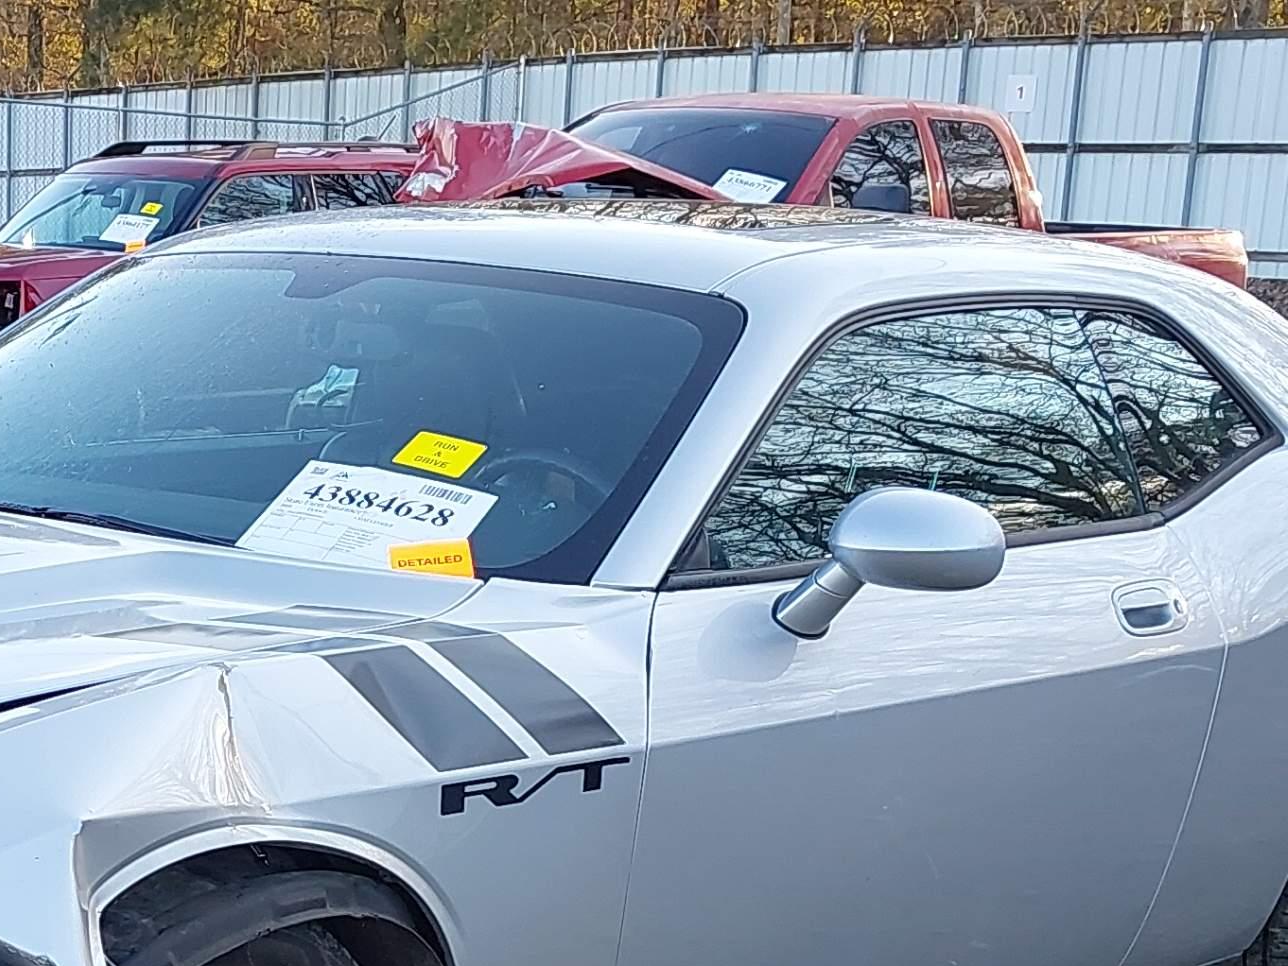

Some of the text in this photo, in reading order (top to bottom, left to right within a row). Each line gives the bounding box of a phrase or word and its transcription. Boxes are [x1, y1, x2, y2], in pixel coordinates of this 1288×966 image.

[1017, 86, 1024, 99] 1
[433, 441, 460, 452] RUN
[414, 455, 451, 469] DRIVE
[304, 483, 455, 527] 43884628
[397, 554, 464, 569] DETAILED
[441, 757, 630, 816] R/T
